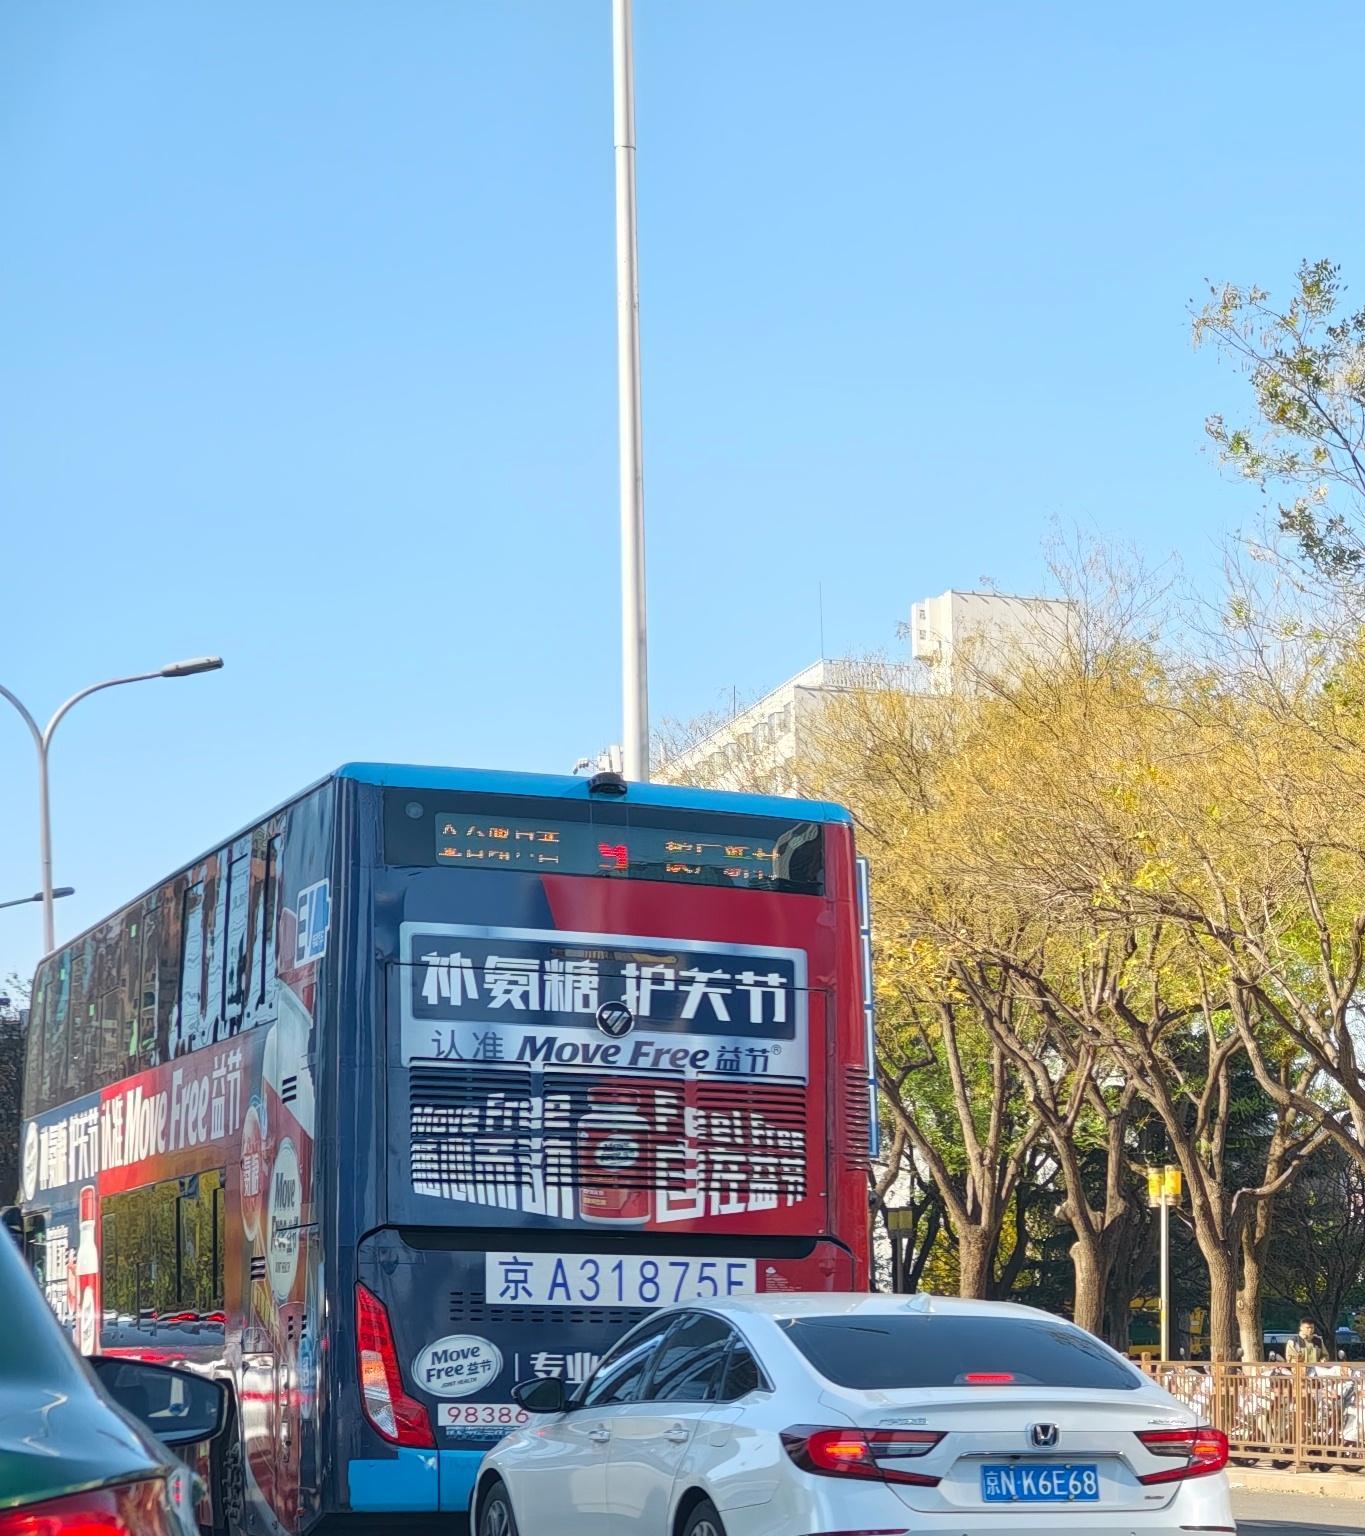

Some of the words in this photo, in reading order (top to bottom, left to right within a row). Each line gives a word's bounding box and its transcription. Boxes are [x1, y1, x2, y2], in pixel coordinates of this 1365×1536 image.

[421, 951, 600, 1014] 补氨糖
[620, 963, 787, 1024] 护关节
[432, 1030, 504, 1060] 认准
[516, 1035, 622, 1064] Move
[628, 1040, 709, 1070] Free
[124, 1086, 168, 1167] Move
[169, 1068, 209, 1152] Free
[211, 1047, 242, 1140] 益节
[274, 1172, 296, 1209] Move
[426, 1364, 464, 1383] Free
[431, 1346, 480, 1365] Move
[447, 1406, 529, 1424] 98386
